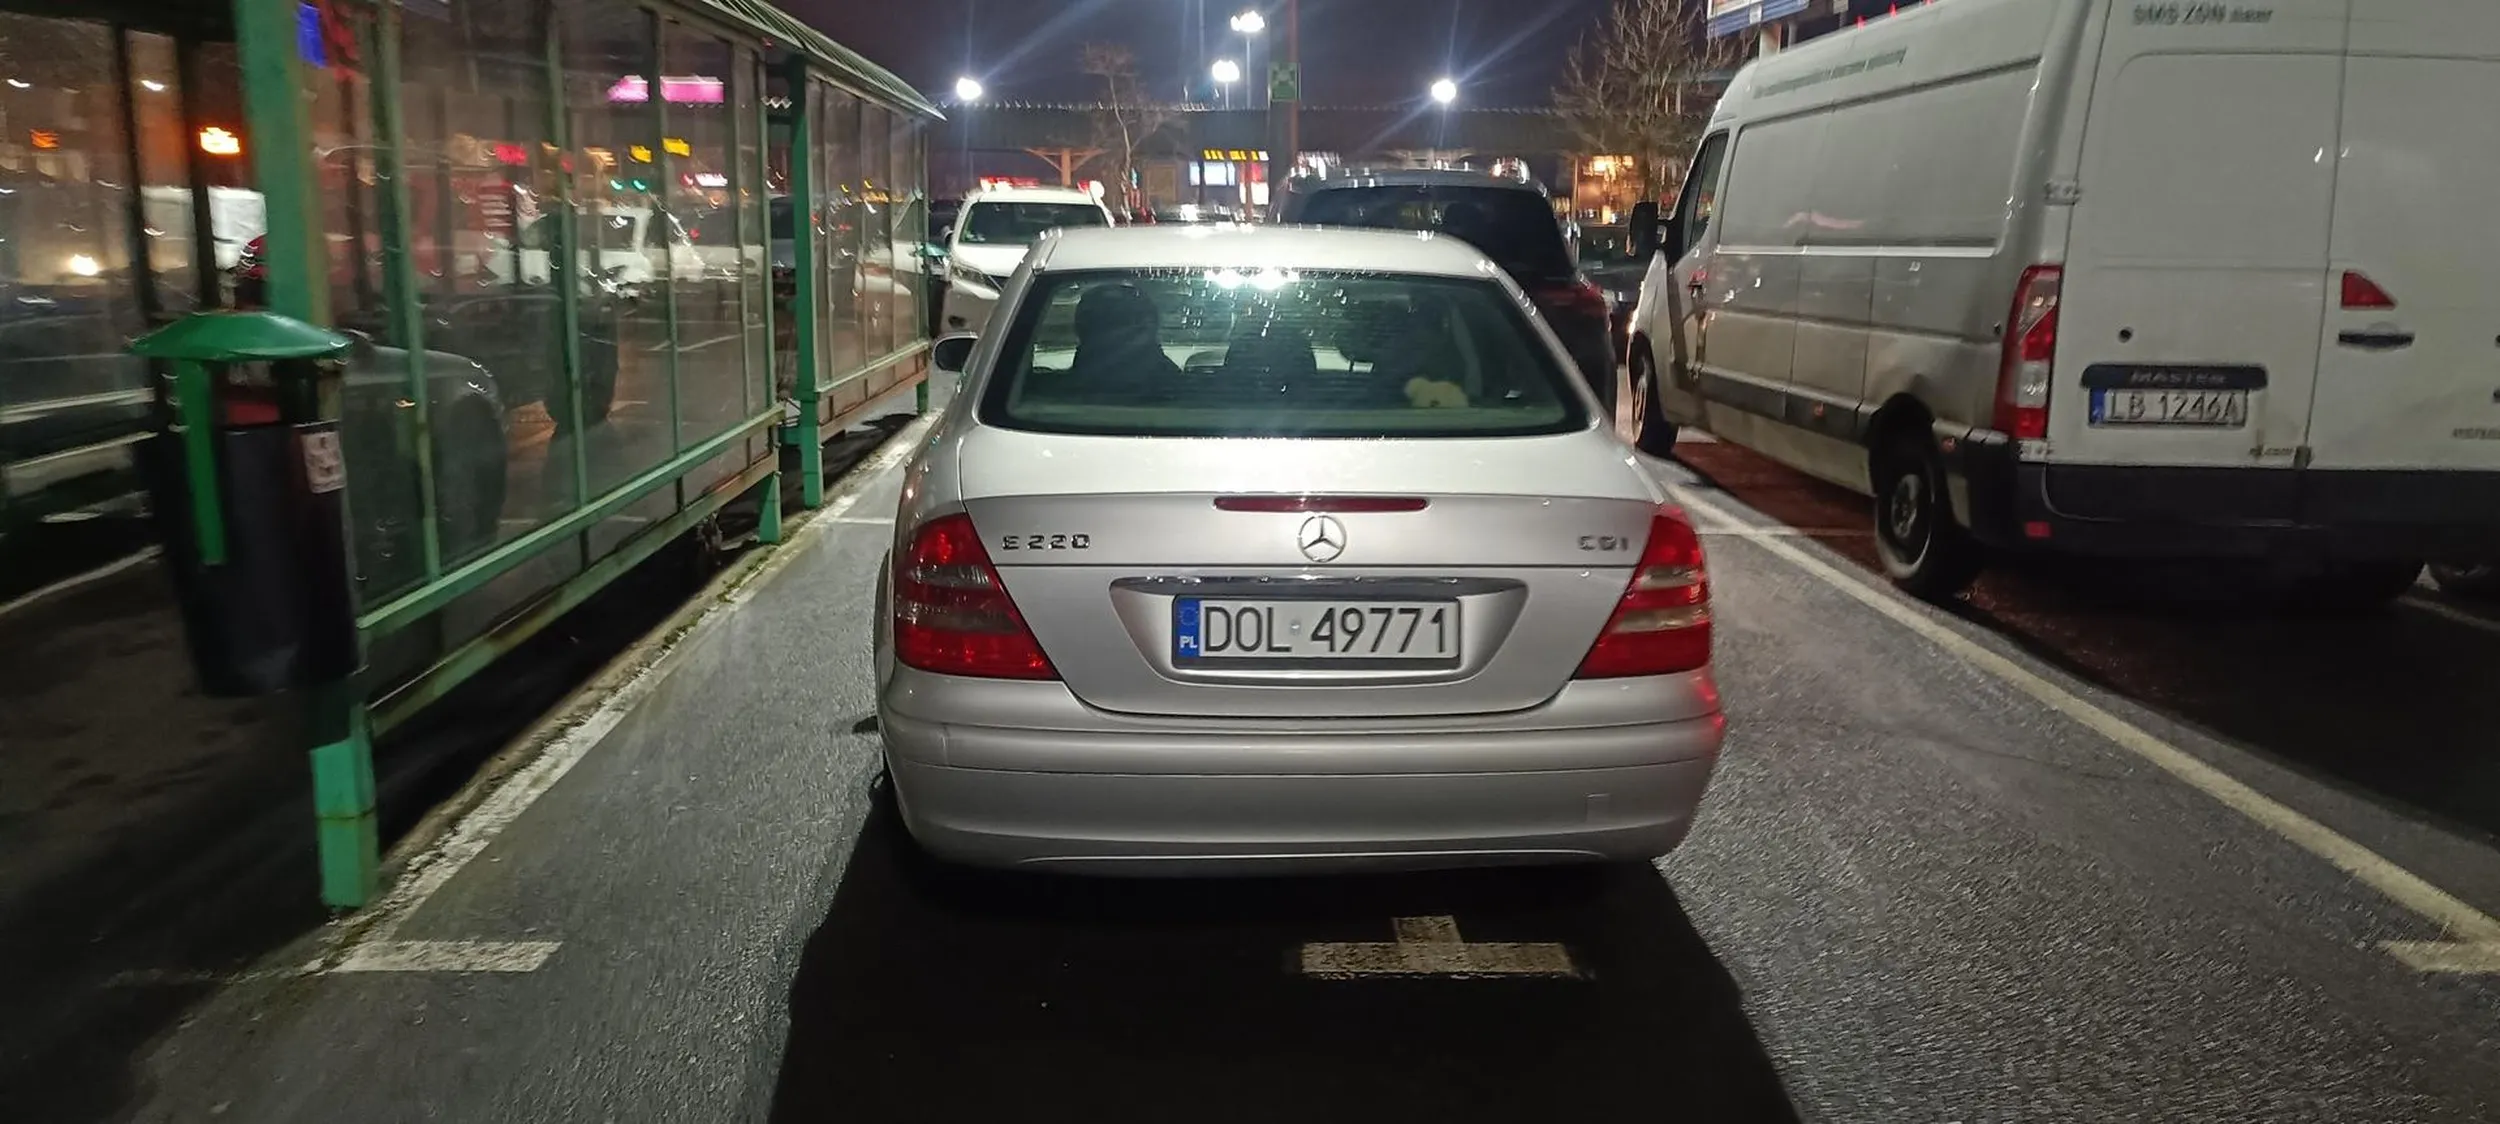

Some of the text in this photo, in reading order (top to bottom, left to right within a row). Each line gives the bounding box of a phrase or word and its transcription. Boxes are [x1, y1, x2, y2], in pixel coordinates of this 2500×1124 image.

[2129, 371, 2228, 385] MASTER
[2108, 390, 2146, 421] LB
[1002, 534, 1091, 550] E 220
[1578, 534, 1630, 551] CDI
[1204, 605, 1446, 653] DOL 49771
[1179, 635, 1198, 648] PL
